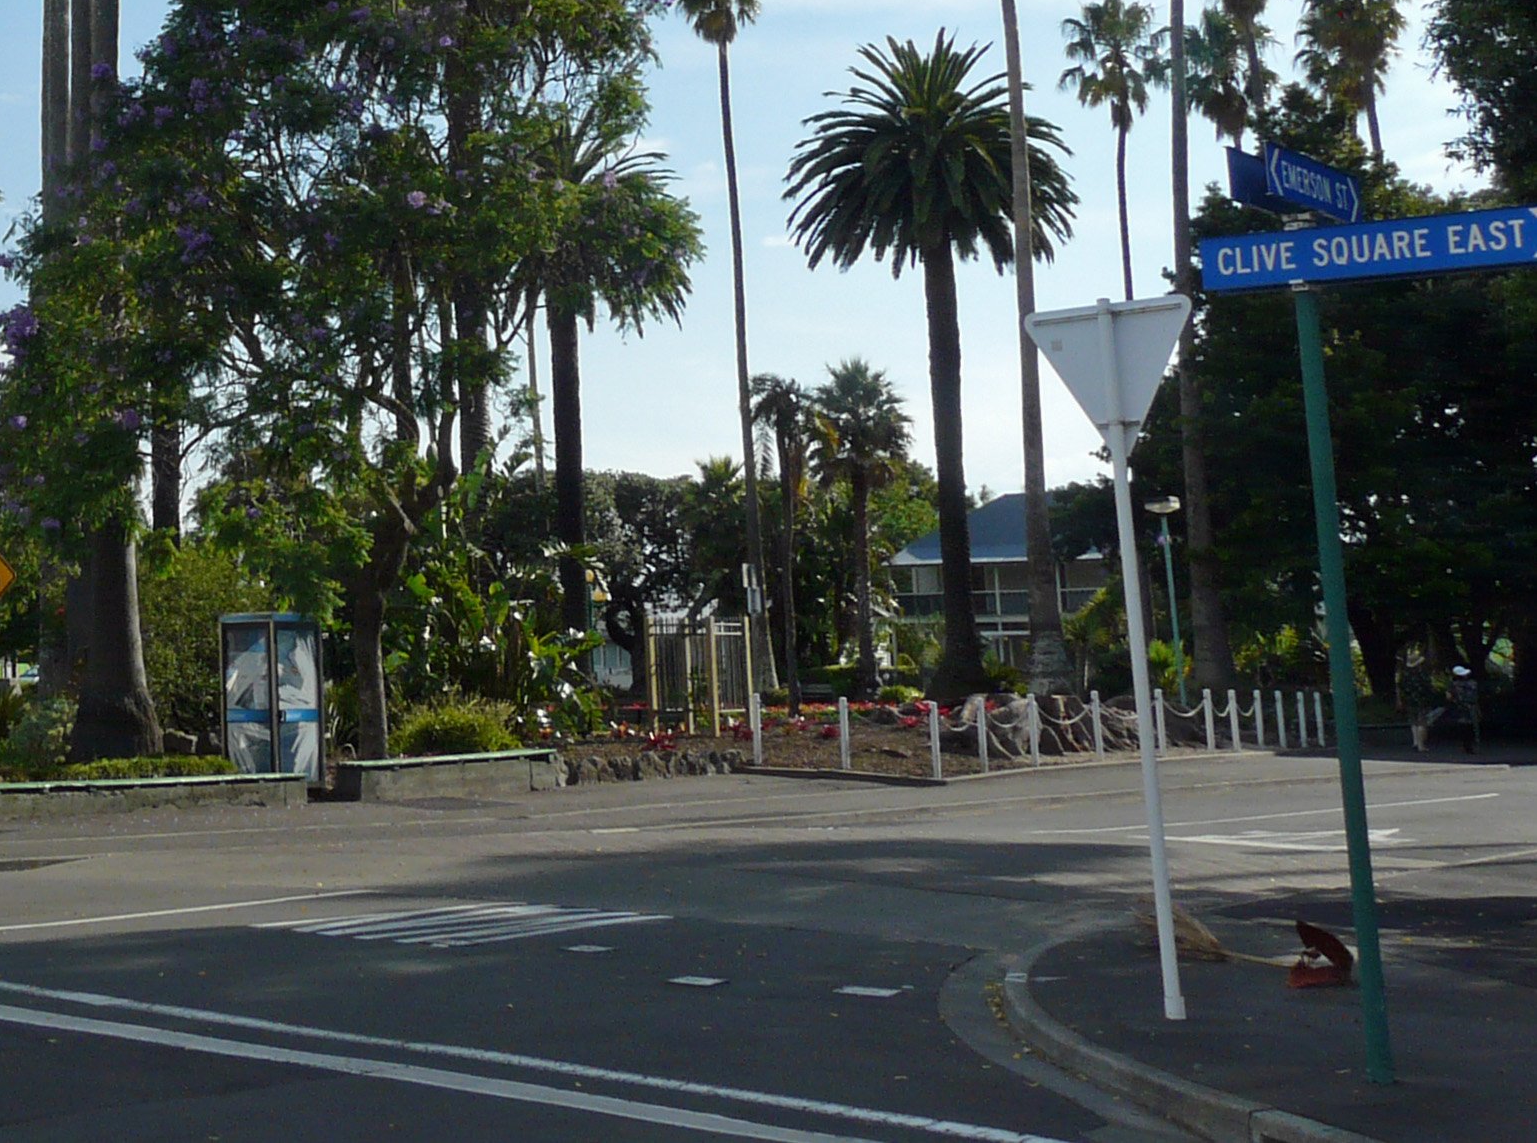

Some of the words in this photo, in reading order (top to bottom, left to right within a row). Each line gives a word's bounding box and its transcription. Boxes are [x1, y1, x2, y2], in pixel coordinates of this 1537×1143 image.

[1281, 160, 1331, 204] EMERSON
[1335, 182, 1348, 210] ST
[1217, 242, 1296, 275] CLIVE
[1313, 230, 1431, 266] SQUARE
[1448, 220, 1525, 254] EAST
